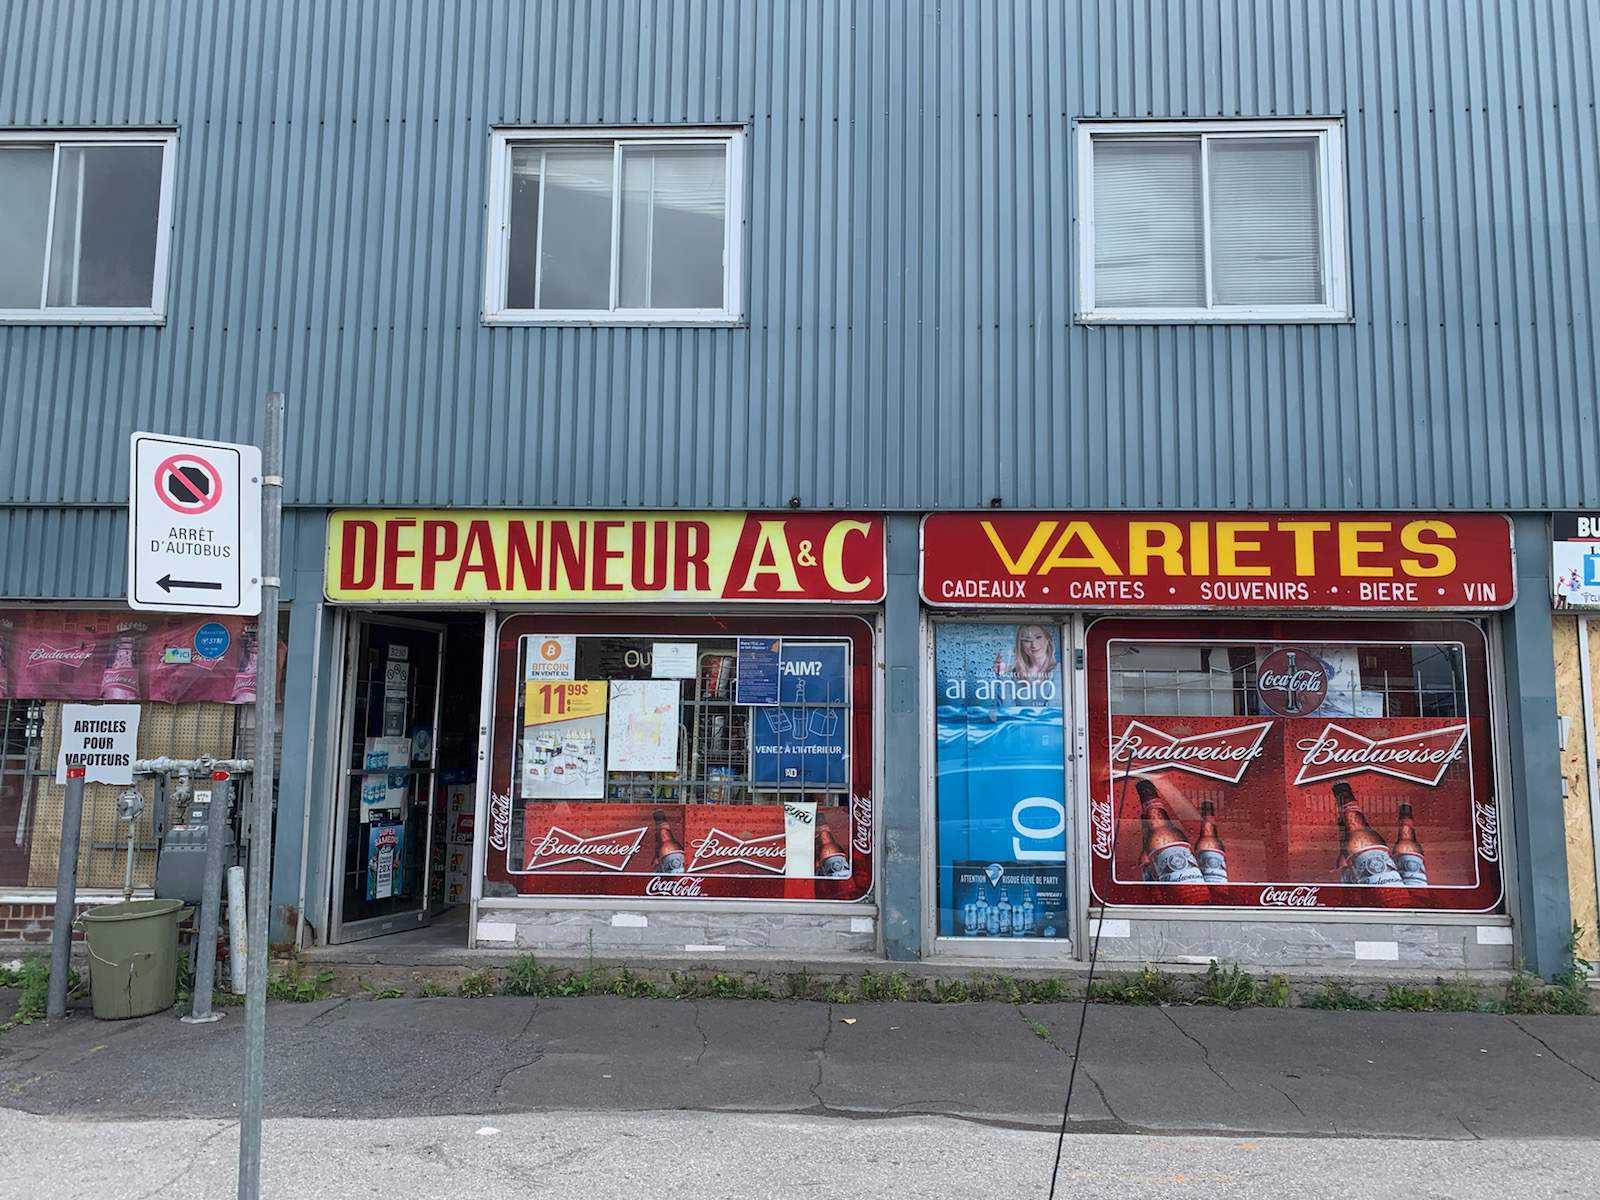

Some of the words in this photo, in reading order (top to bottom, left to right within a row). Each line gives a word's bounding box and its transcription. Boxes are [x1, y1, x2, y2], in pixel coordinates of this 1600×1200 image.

[168, 527, 215, 542] ARRÊT
[151, 540, 231, 558] D'AUTOBUS
[980, 519, 1457, 577] VARIETES
[942, 580, 1026, 598] CADEAUX
[1070, 581, 1145, 599] CARTES
[1200, 582, 1309, 600] SOUVENIRS
[1360, 583, 1418, 601] BIERE
[1463, 583, 1496, 602] VIN
[28, 648, 94, 662] Budweiser
[532, 663, 569, 671] BITCOIN
[975, 679, 1056, 700] amaro
[1259, 670, 1322, 692] Coca-Cola
[74, 720, 126, 733] ARTICLES
[83, 737, 114, 750] POUR
[1111, 735, 1263, 762] Budweiser
[1296, 738, 1463, 765] Budweiser
[65, 752, 130, 767] VAPOTEURS
[489, 792, 511, 850] Coca-Cola
[784, 804, 813, 824] GURU
[853, 794, 873, 854] Coca-Cola
[1092, 799, 1112, 859] Coca-Cola
[1475, 801, 1498, 862] Coca-Cola
[530, 836, 640, 857] Budweiser
[691, 839, 787, 858] Budweise
[646, 876, 705, 896] Coca-Cola
[1260, 886, 1320, 906] Coca-Cola
